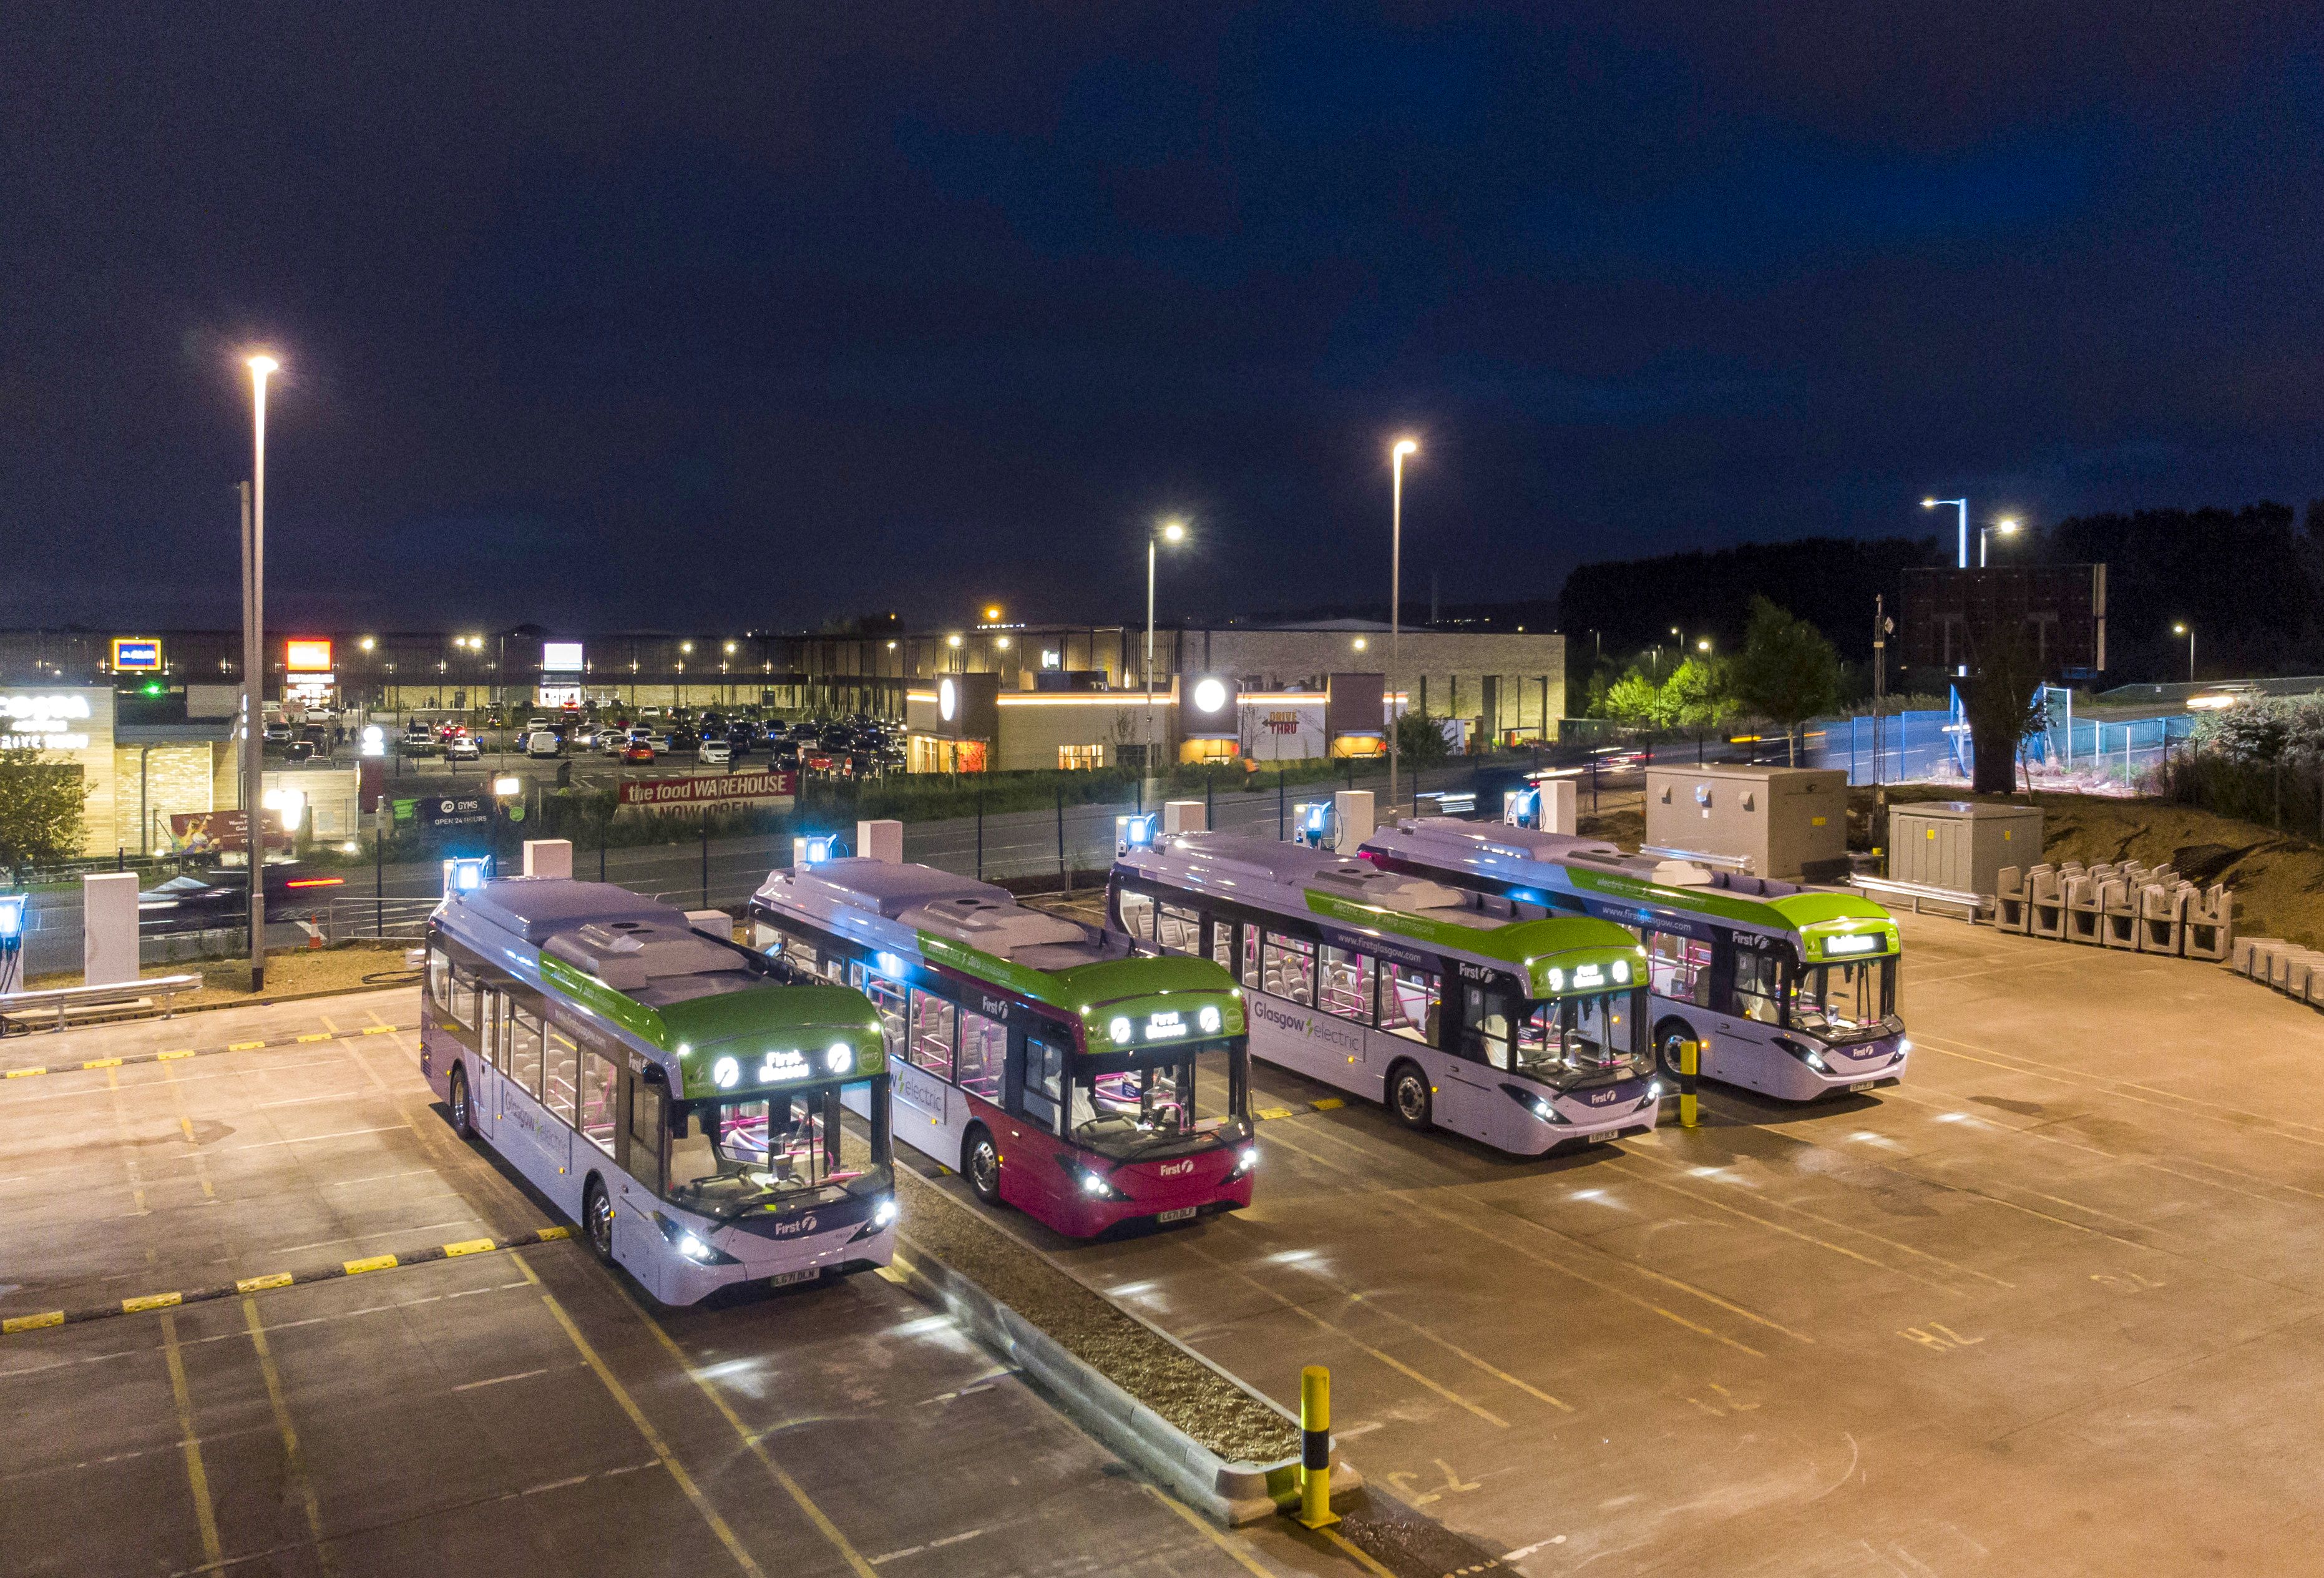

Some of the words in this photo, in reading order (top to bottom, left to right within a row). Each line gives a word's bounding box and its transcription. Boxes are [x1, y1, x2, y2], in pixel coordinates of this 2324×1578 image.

[1269, 711, 1297, 722] DRIVE
[1270, 722, 1297, 735] THRU
[628, 784, 654, 802] the
[657, 782, 691, 800] food
[695, 774, 788, 797] WAREHOUSE
[457, 801, 478, 810] GYMS
[1602, 906, 1691, 931] www.firstglasgow.com
[1732, 930, 1753, 946] First
[1337, 934, 1421, 963] www.firstglasgow.com
[1459, 962, 1479, 980] First
[983, 996, 998, 1015] First
[1254, 1001, 1305, 1032] Glasgow
[1314, 1022, 1359, 1051] electric
[1853, 1047, 1866, 1057] First
[628, 1051, 642, 1081] First
[905, 1076, 942, 1111] electric
[1591, 1094, 1607, 1104] First
[505, 1090, 535, 1132] Glasgow
[1160, 1164, 1181, 1176] First
[775, 1221, 801, 1235] First
